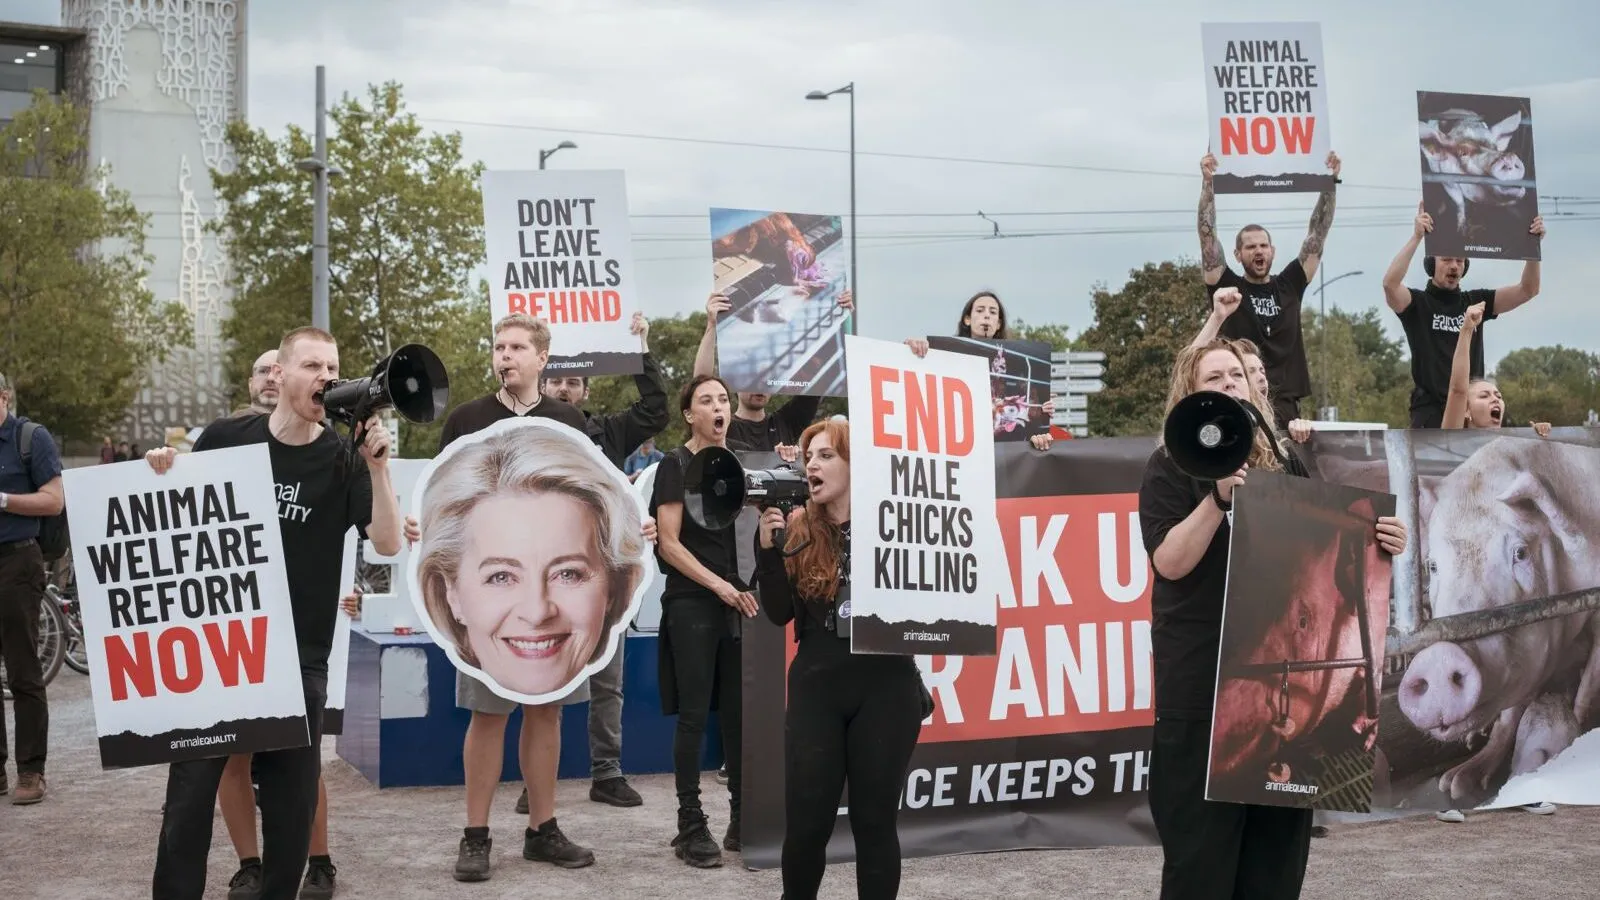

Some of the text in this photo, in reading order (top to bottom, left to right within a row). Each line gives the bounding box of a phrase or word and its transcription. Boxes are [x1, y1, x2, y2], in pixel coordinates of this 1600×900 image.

[1225, 40, 1308, 63] ANIMAL
[1214, 65, 1318, 88] WELFARE
[1224, 90, 1312, 114] REFORM
[1220, 116, 1315, 155] NOW
[517, 198, 596, 227] DON'T
[518, 229, 602, 258] LEAVE
[503, 259, 621, 290] ANIMALS
[507, 290, 622, 324] BEHIND
[869, 365, 975, 457] END
[891, 455, 961, 502] MALE
[106, 481, 249, 537] ANIMAL
[878, 500, 973, 548] CHICKS
[87, 524, 269, 584] WELFARE
[874, 546, 977, 594] KILLING
[107, 570, 261, 628] REFORM
[103, 616, 269, 701] NOW
[899, 766, 958, 810] CE
[969, 756, 1097, 804] KEEPS
